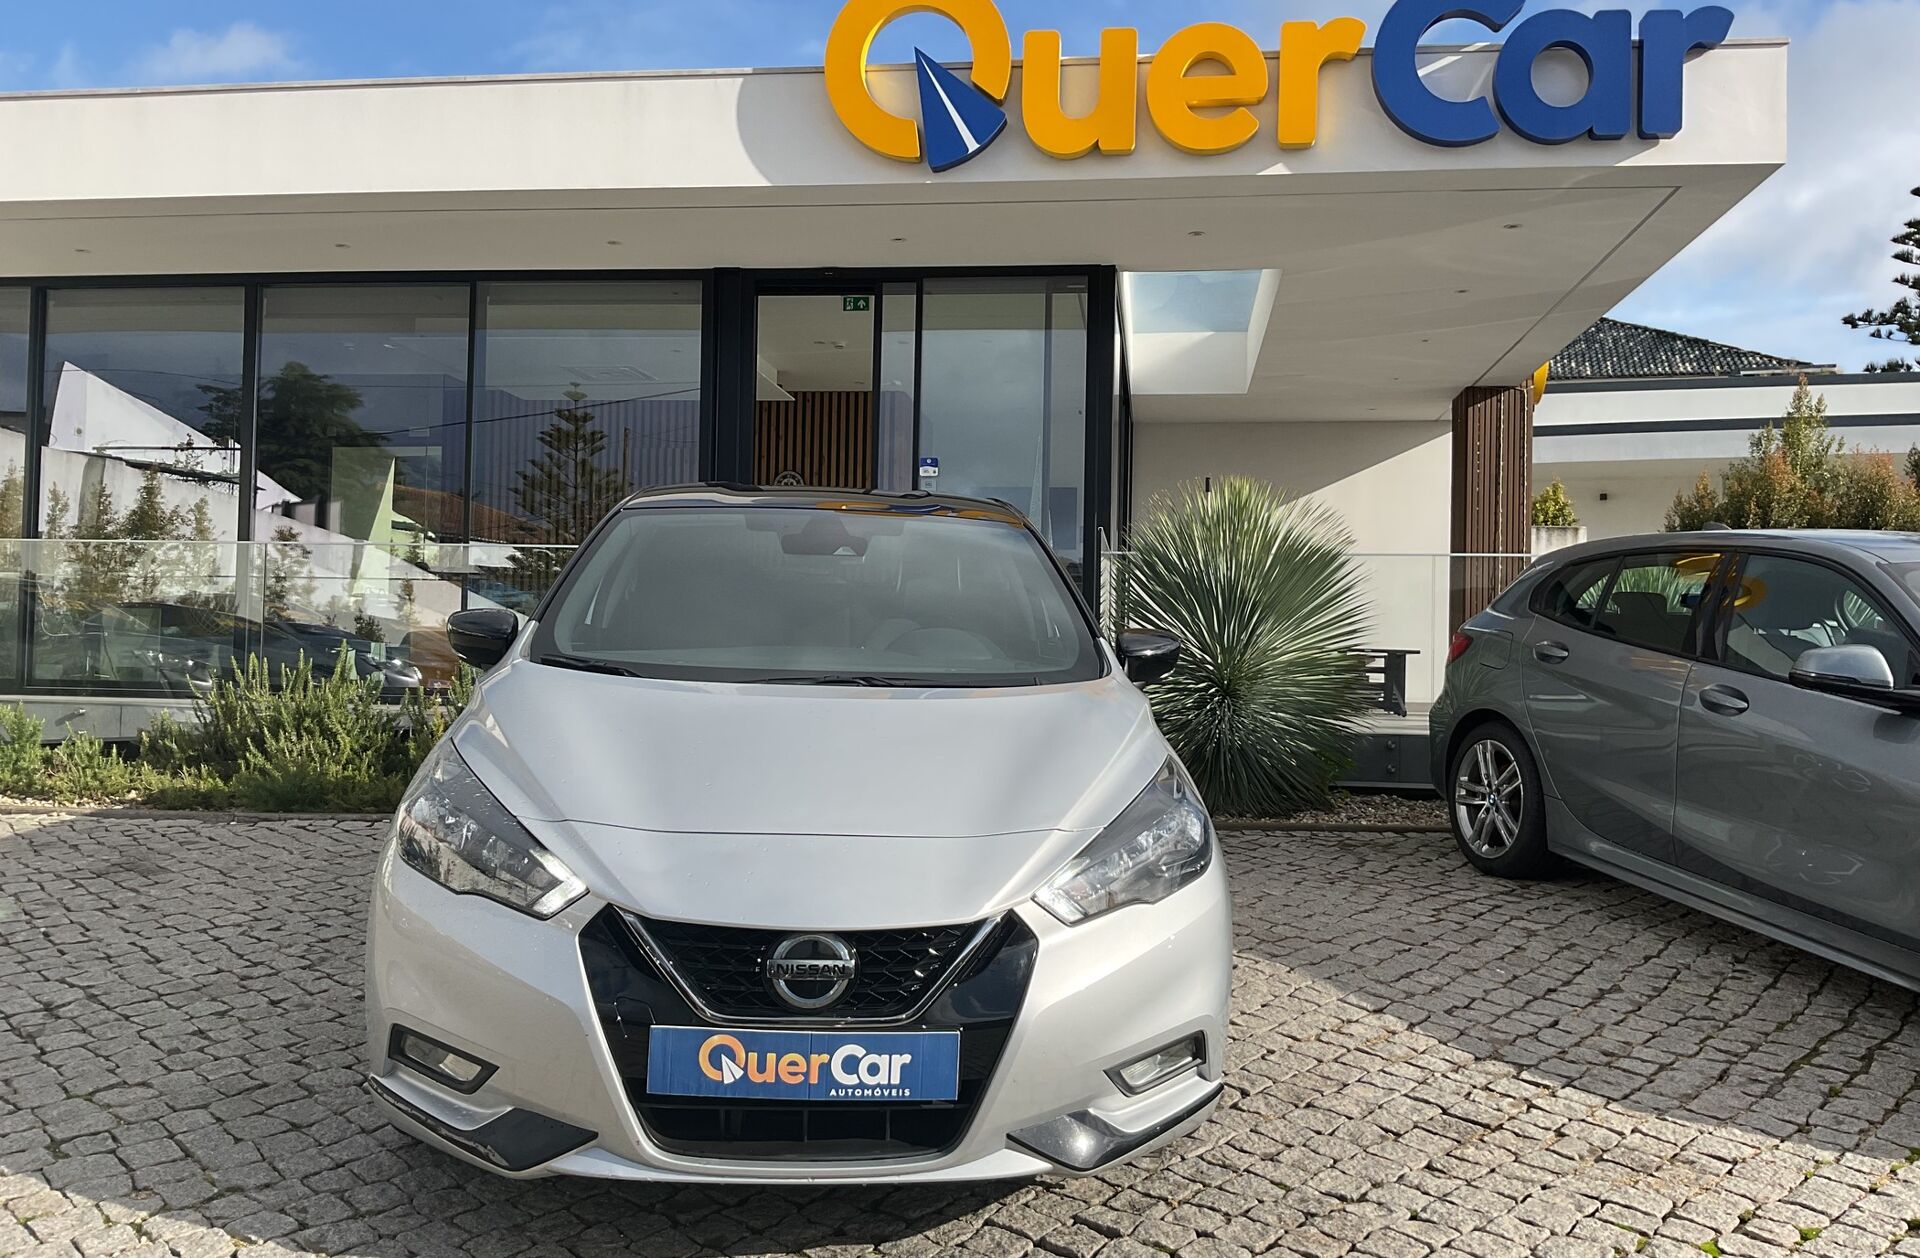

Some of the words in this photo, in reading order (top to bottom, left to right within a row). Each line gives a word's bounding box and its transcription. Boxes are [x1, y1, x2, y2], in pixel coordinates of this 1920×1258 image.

[824, 0, 1735, 174] QuerCar
[776, 963, 846, 975] NISSAN
[698, 1034, 912, 1085] QuerCar
[829, 1087, 911, 1097] AUTOMÓVEIS
